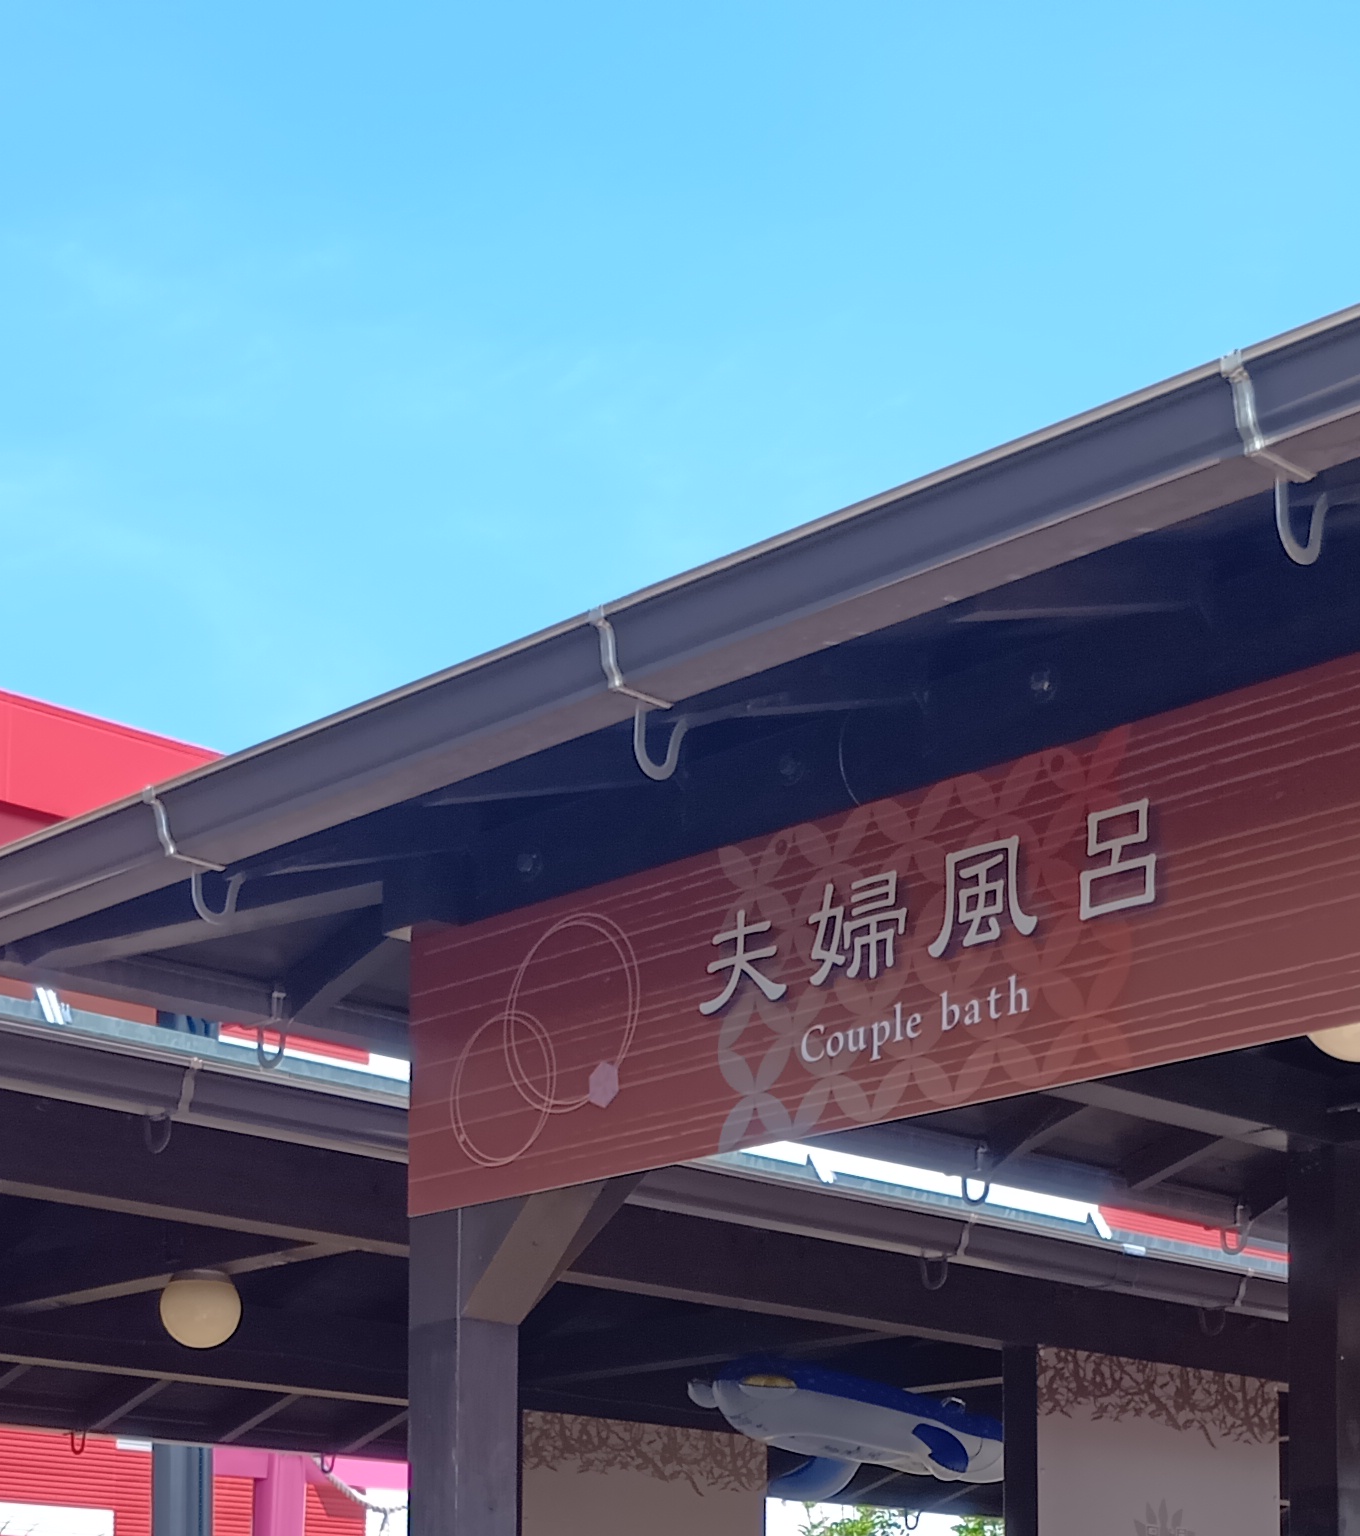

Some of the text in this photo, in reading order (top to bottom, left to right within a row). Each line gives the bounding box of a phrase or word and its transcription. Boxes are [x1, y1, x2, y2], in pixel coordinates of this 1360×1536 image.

[699, 798, 1158, 1016] 夫婦風呂
[800, 975, 1031, 1066] Couple bath
